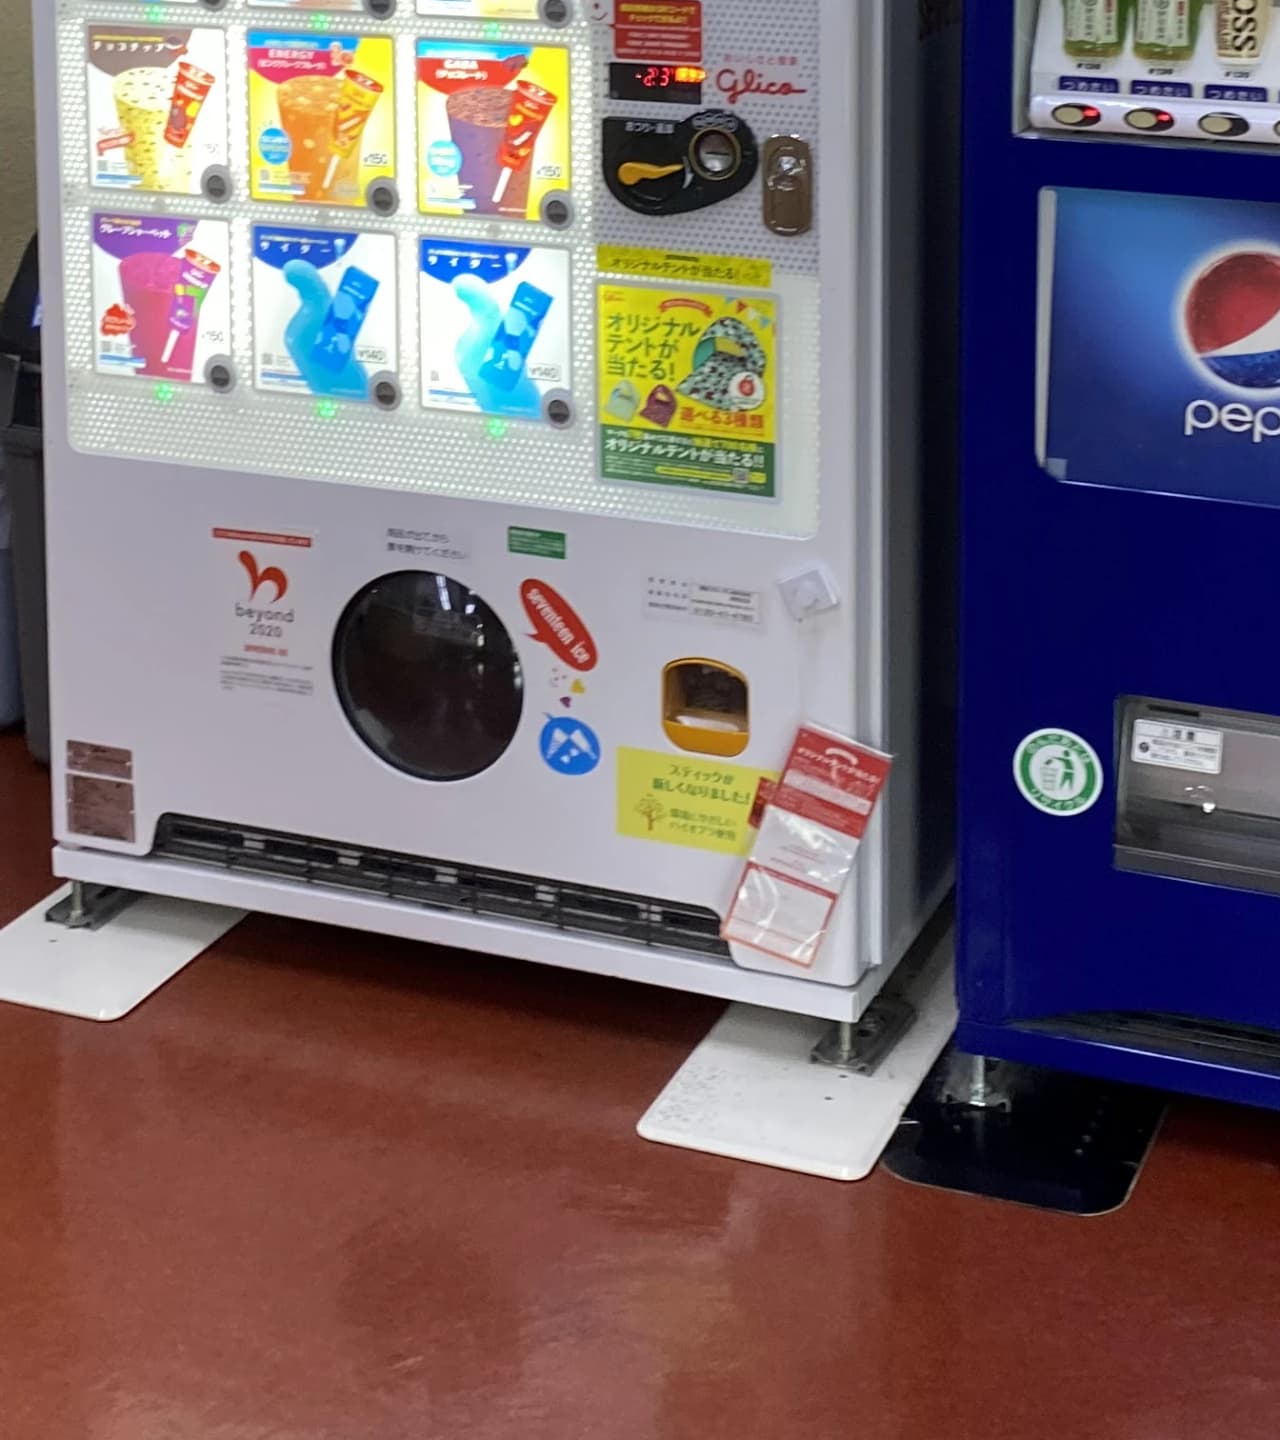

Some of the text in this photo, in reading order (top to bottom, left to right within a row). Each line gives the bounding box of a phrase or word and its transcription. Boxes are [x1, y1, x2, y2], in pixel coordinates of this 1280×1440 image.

[716, 68, 807, 104] Glico
[606, 312, 701, 337] オリジナル
[606, 336, 680, 359] テントが
[607, 359, 676, 382] 当たる!
[235, 602, 295, 623] beyond
[249, 623, 283, 638] 2020
[525, 586, 574, 647] seventeen
[570, 637, 591, 664] ice
